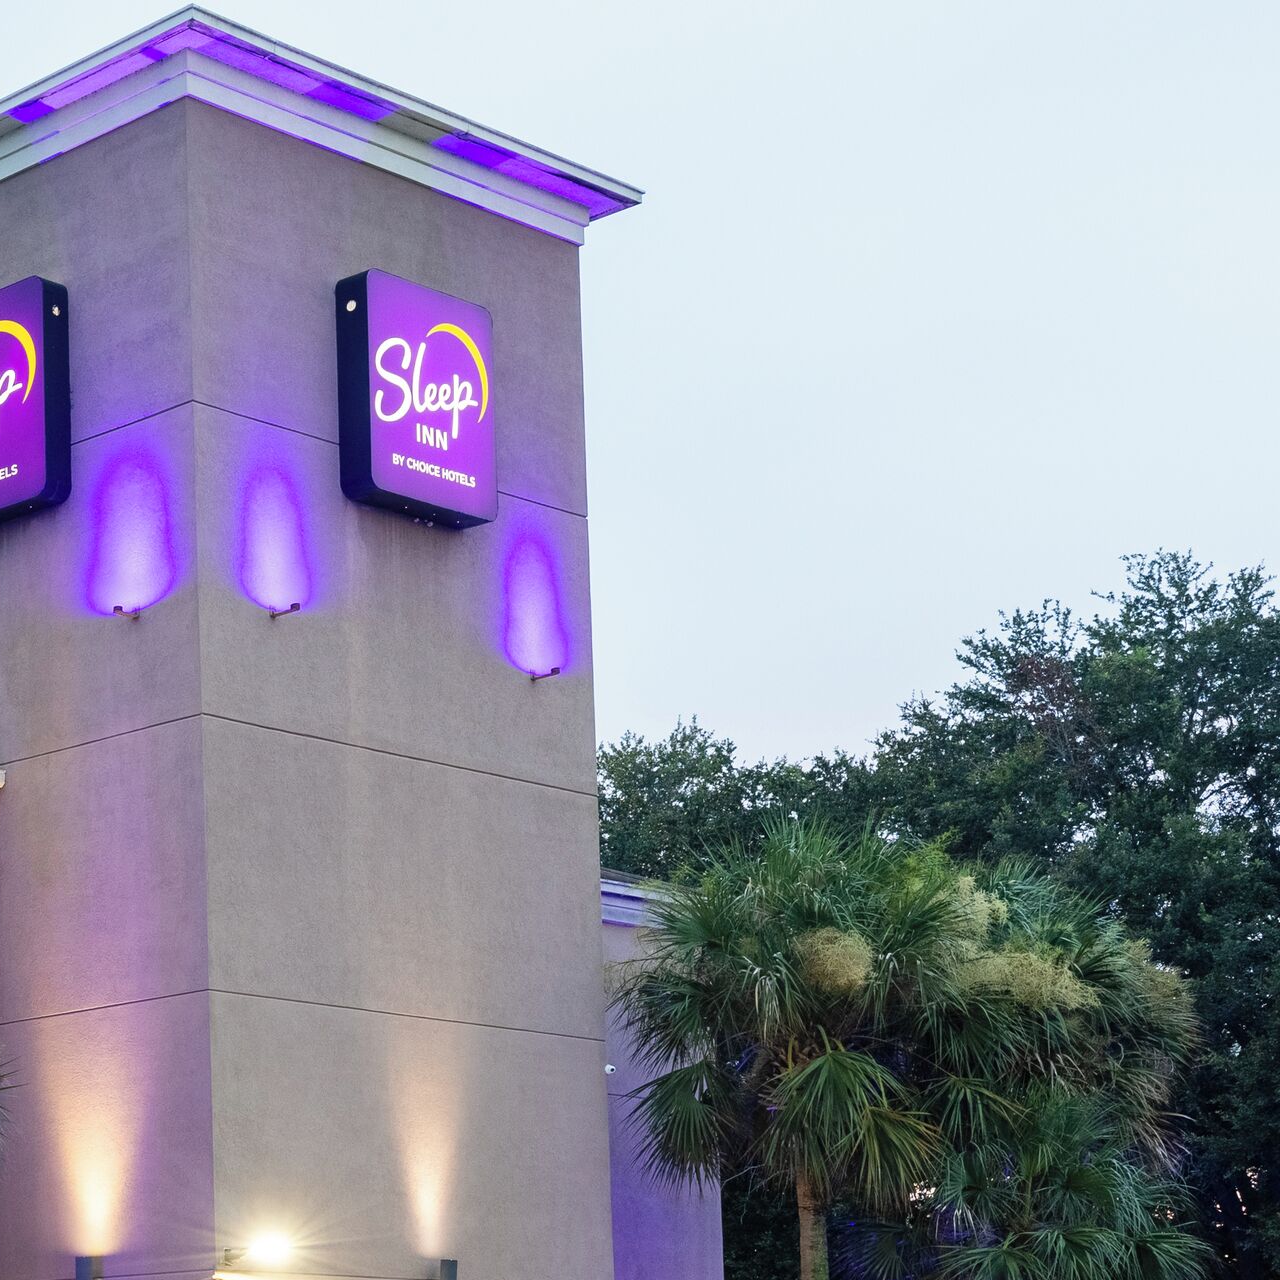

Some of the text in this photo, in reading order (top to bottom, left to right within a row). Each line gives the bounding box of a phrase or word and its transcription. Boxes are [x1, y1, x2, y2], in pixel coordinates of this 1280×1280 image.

[374, 337, 479, 439] Sleep
[416, 422, 448, 451] INN
[392, 452, 477, 488] BY CHOICE HOTELS
